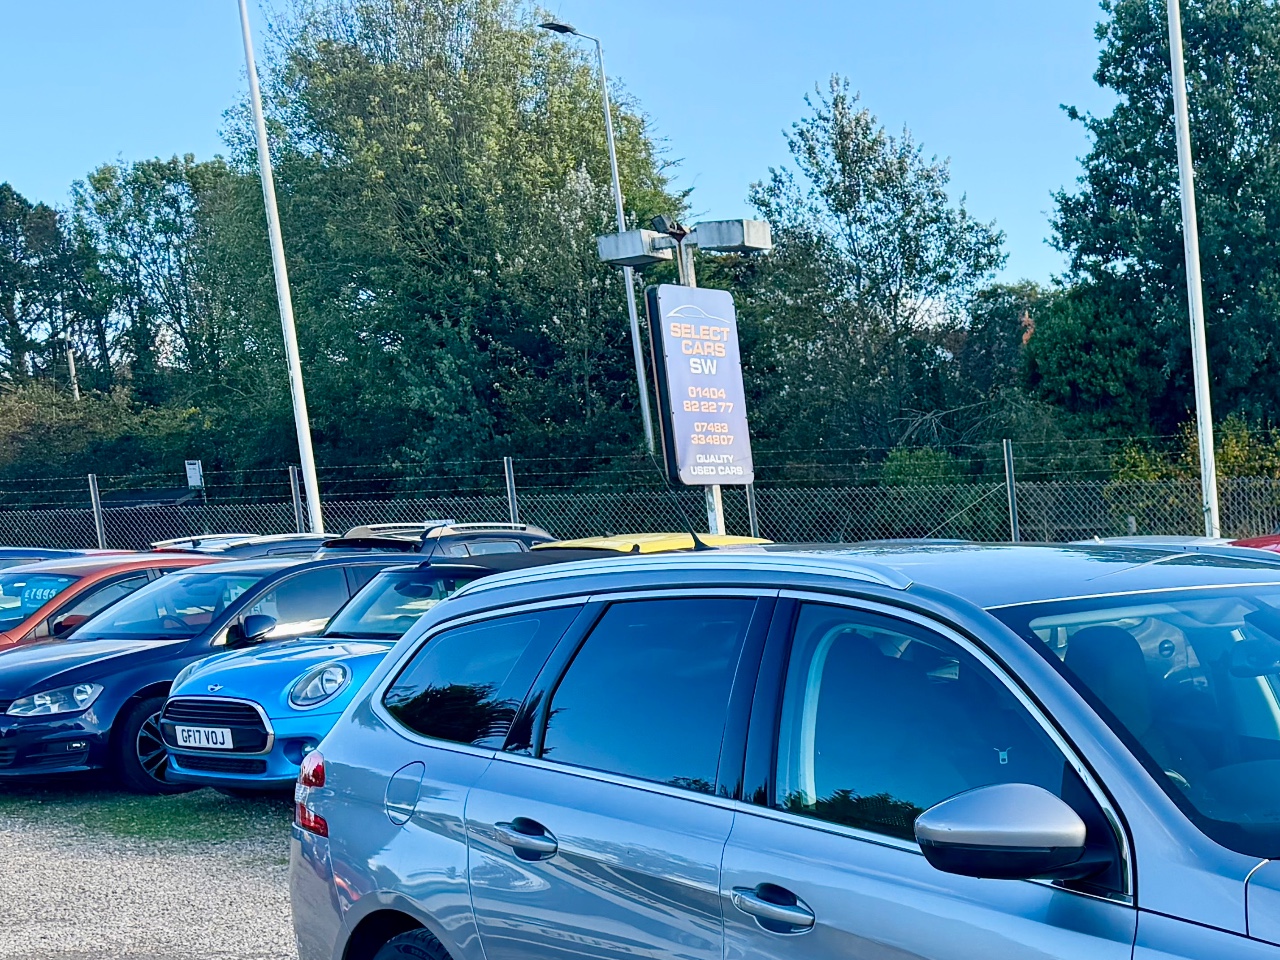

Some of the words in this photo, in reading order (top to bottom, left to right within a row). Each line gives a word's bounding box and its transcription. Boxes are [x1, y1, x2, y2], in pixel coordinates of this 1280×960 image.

[670, 323, 730, 341] SELECT
[681, 340, 726, 357] CARS
[689, 357, 717, 375] SW
[688, 386, 726, 399] 01404
[683, 400, 700, 412] 82
[700, 401, 717, 413] 22
[718, 402, 734, 414] 77
[696, 454, 734, 463] QUALITY
[690, 465, 717, 475] USED
[717, 466, 744, 476] CARS
[181, 729, 201, 744] GF17
[203, 729, 225, 745] VOJ
